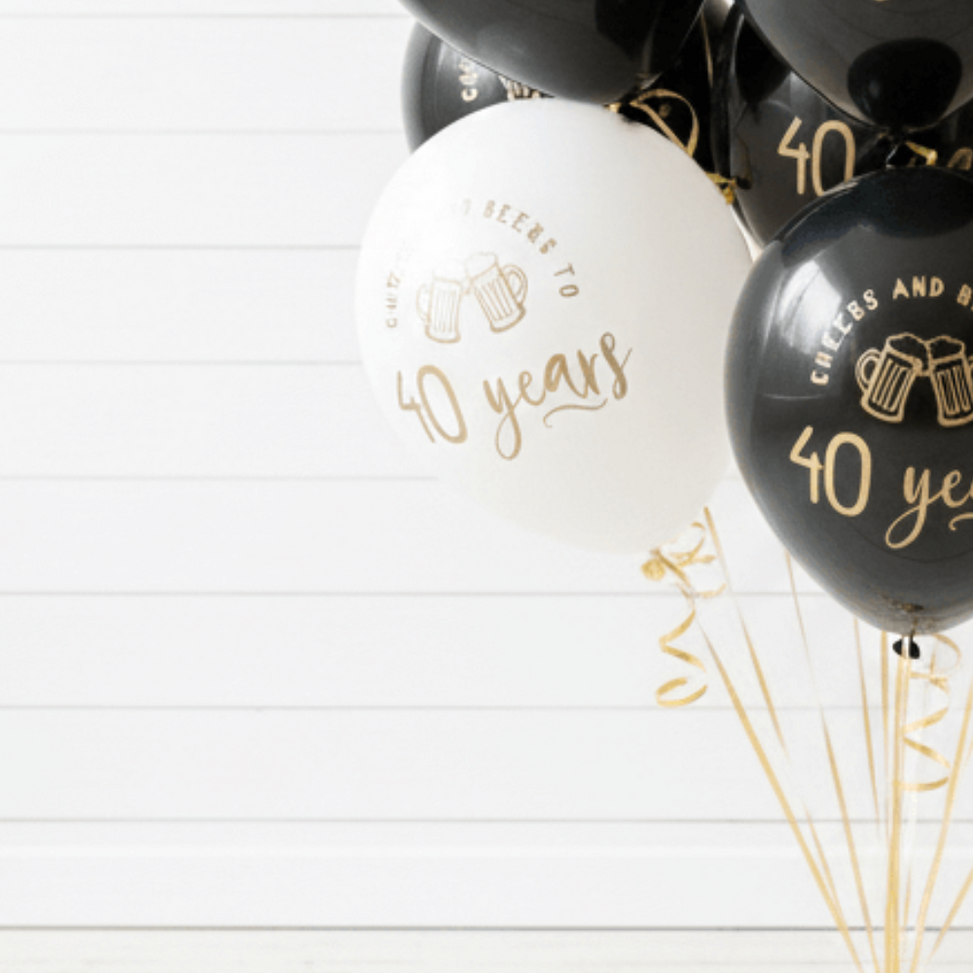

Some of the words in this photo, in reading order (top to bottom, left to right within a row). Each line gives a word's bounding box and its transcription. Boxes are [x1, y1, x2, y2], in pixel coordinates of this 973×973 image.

[777, 116, 856, 197] 40
[553, 262, 580, 298] TO
[892, 275, 945, 300] AND
[396, 364, 468, 444] 40
[482, 331, 633, 461] years
[789, 425, 872, 517] 40
